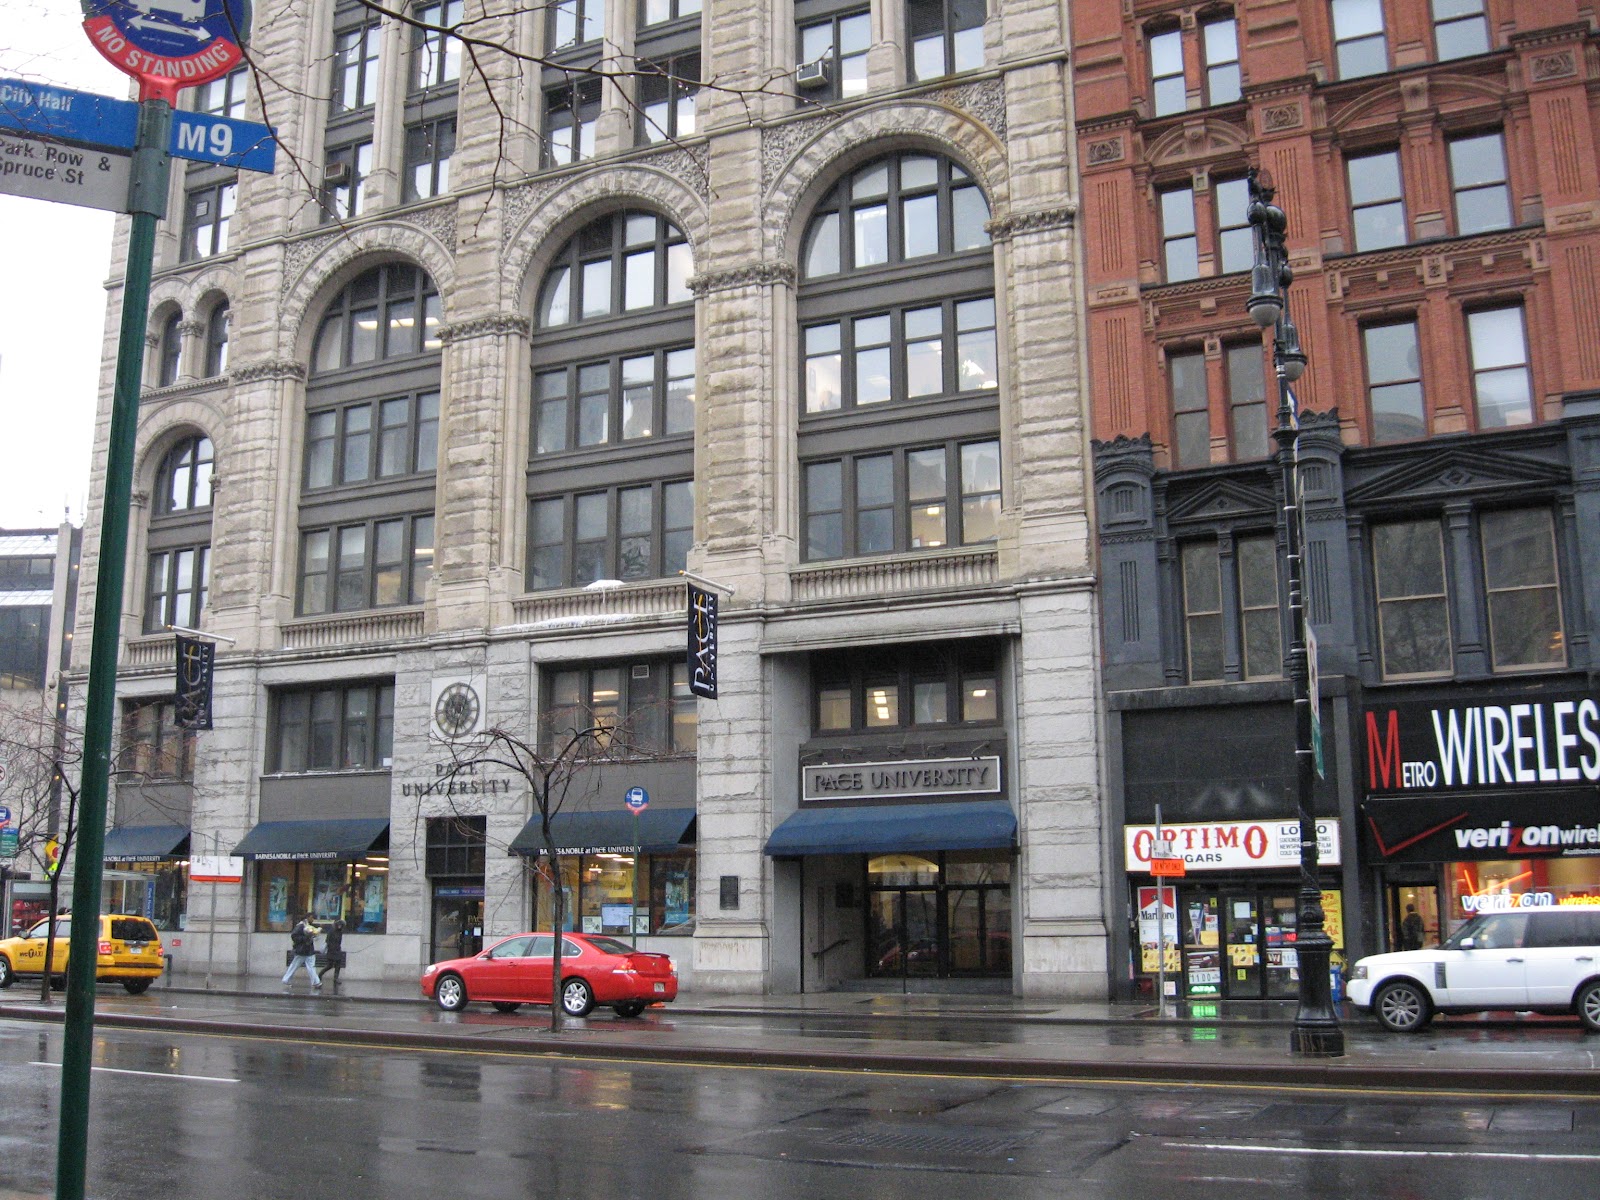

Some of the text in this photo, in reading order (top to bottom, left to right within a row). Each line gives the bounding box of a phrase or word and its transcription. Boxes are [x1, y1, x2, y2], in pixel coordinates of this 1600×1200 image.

[96, 26, 230, 78] NO STANDING
[1, 85, 72, 112] City Hall
[178, 122, 233, 157] M9
[0, 157, 84, 185] pruce St
[46, 146, 84, 167] Row
[98, 156, 111, 172] &
[1366, 710, 1437, 789] METRO
[402, 779, 511, 797] UNIVERSITY
[814, 766, 989, 792] PACE UNIVERSITY
[1133, 825, 1268, 862] OPTIMO
[1281, 825, 1327, 835] LOO
[1455, 820, 1560, 854] verizon
[1462, 889, 1553, 911] verizon
[1141, 908, 1175, 921] Marloro
